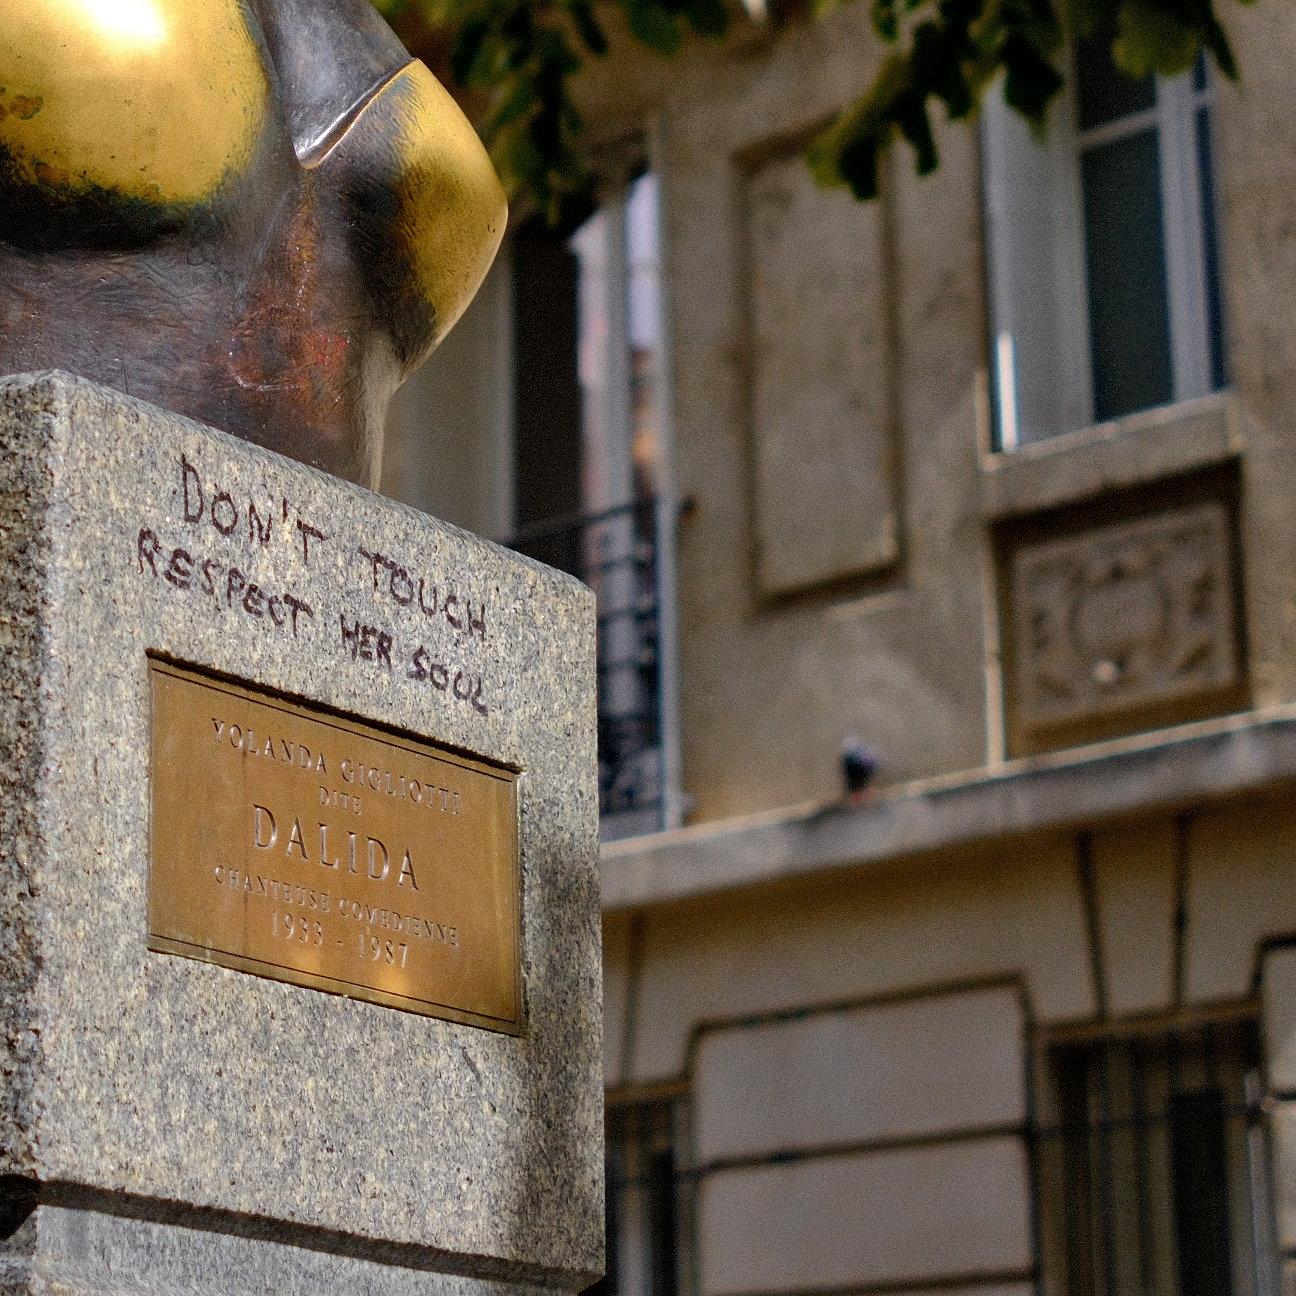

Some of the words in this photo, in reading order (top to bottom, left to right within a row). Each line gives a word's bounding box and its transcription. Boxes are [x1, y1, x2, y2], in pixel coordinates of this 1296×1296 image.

[179, 454, 328, 565] DON'T
[359, 547, 487, 642] TOUCH
[137, 527, 314, 637] RESPECT
[340, 613, 394, 671] HER
[408, 645, 489, 716] SOUL
[211, 718, 328, 775] YOLANDA
[341, 759, 461, 815] GIGLIOTTI
[319, 786, 362, 815] DITE
[253, 803, 420, 891] DALIDA
[213, 864, 330, 913] CHANTEUSE
[338, 898, 461, 948] COMEDIENNE
[271, 911, 324, 948] 1933
[358, 933, 410, 968] 1987
